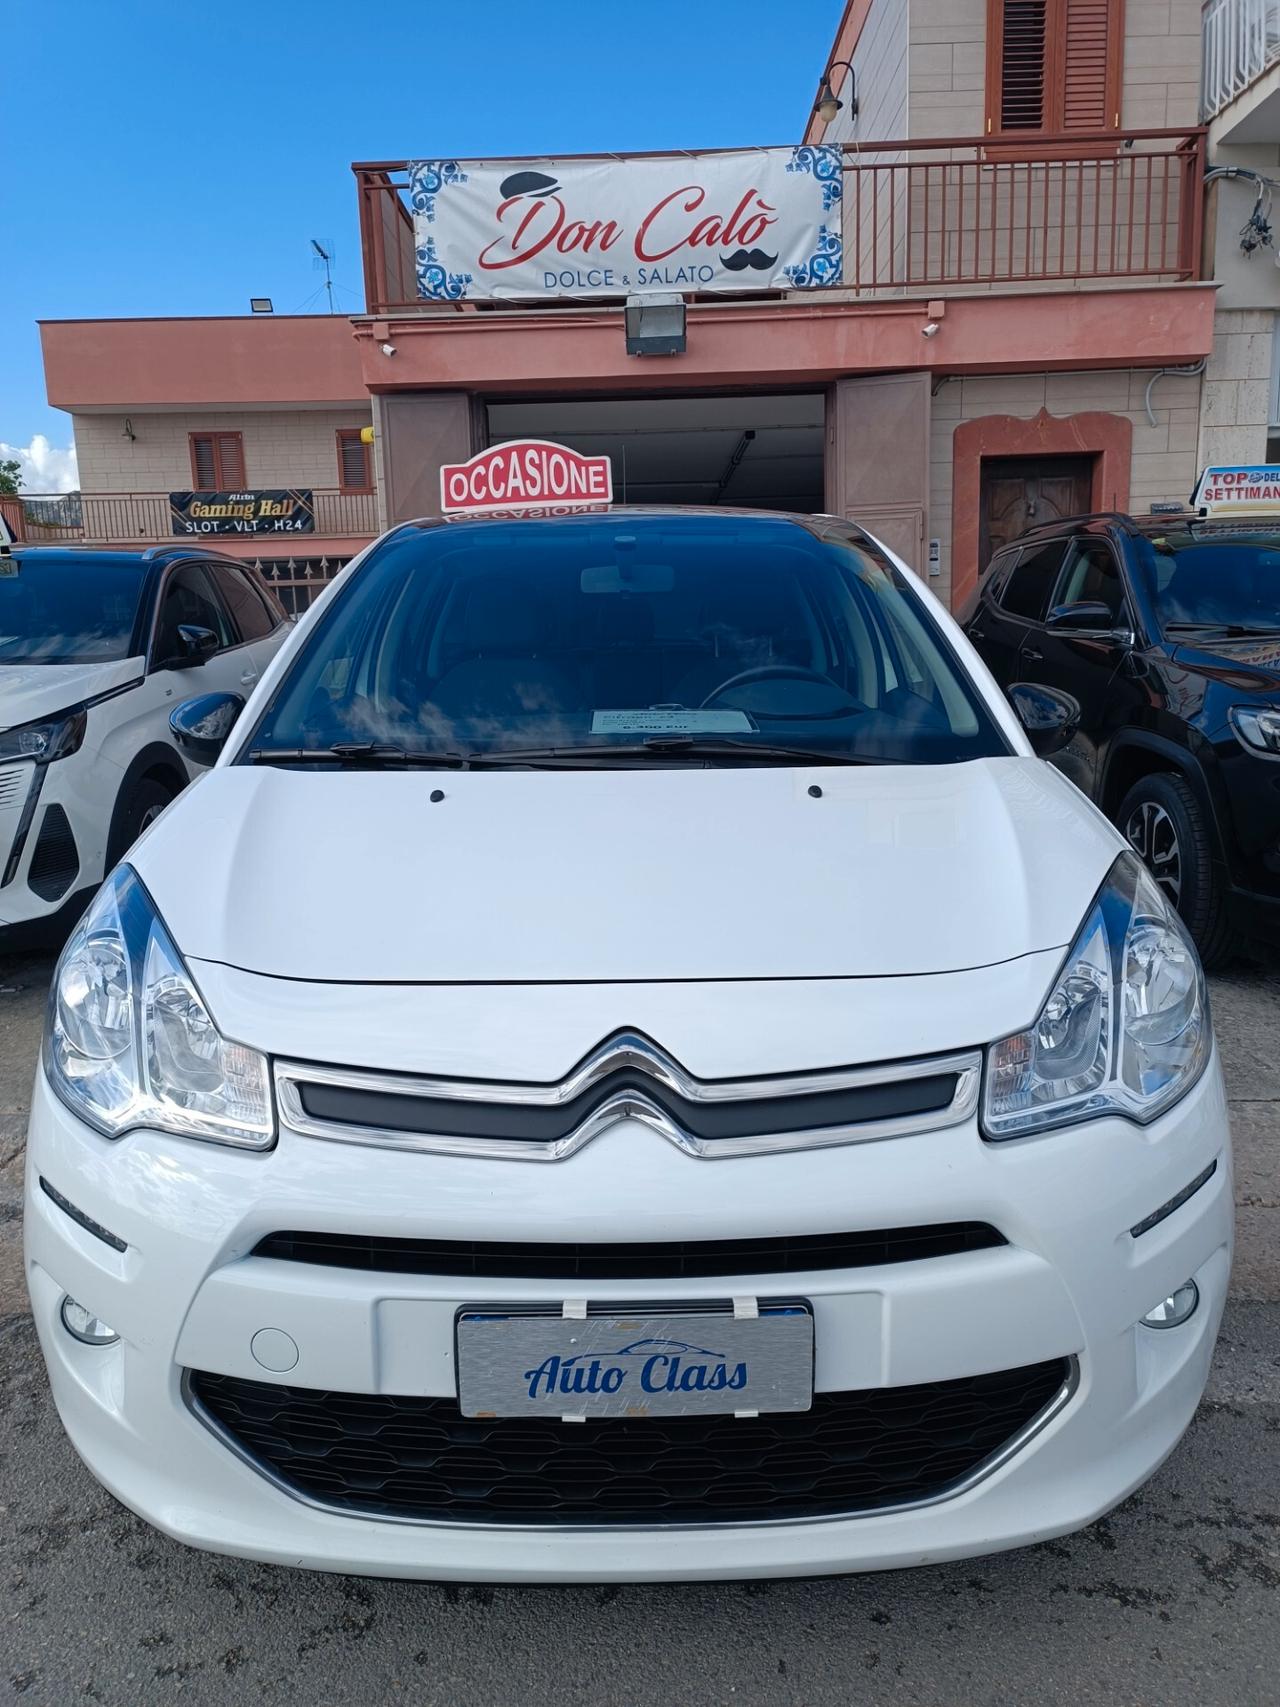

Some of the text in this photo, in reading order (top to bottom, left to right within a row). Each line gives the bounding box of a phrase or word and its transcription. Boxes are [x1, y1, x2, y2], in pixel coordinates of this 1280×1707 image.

[478, 185, 779, 270] Don Calò
[544, 264, 714, 289] DOLCE & SALATO
[450, 449, 606, 502] OCCASIONE
[1210, 472, 1248, 486] TOP
[190, 499, 294, 520] Gaming Hall
[186, 519, 303, 533] SLOT VLT H24
[524, 1354, 748, 1398] Auto Class
